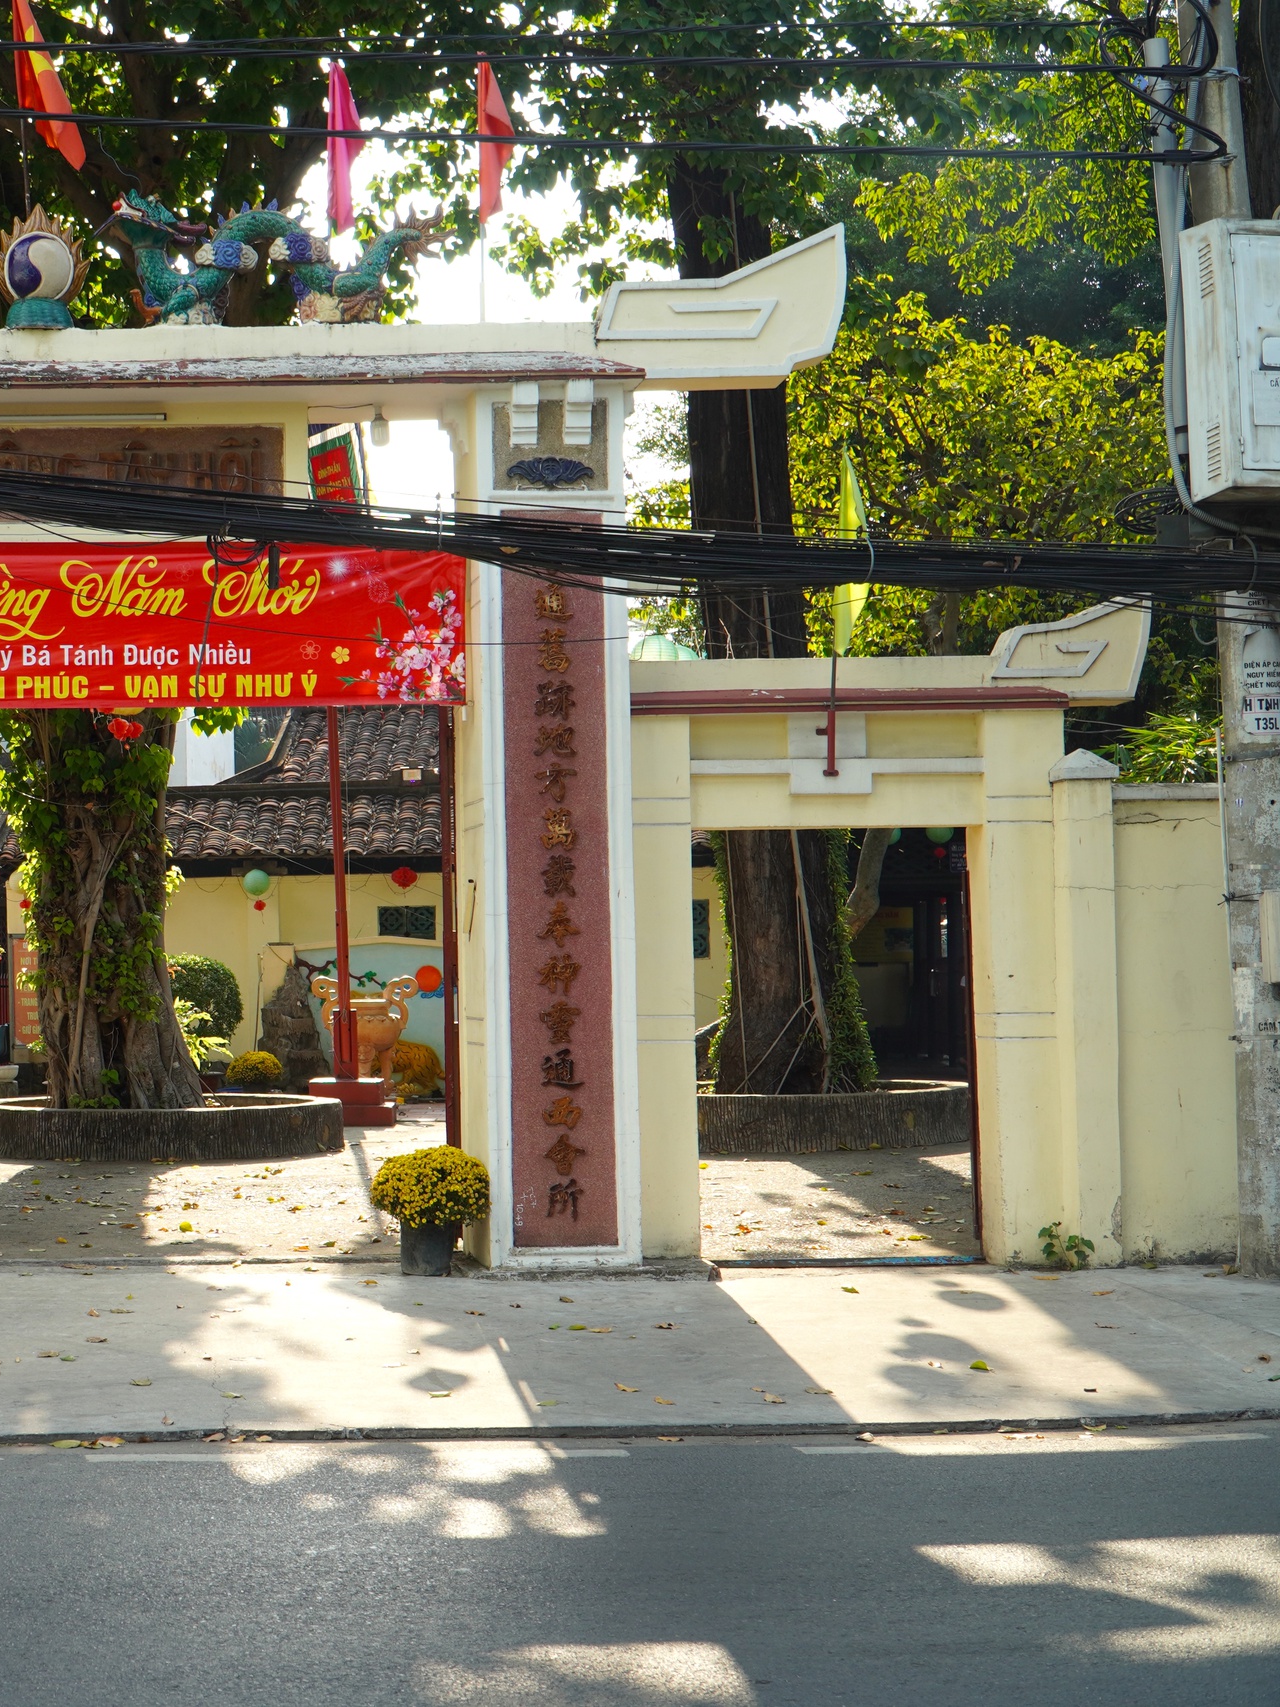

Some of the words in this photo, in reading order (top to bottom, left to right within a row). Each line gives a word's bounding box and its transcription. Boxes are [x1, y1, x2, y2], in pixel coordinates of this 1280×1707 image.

[59, 555, 188, 617] Năm
[202, 557, 320, 617] Mới
[22, 645, 51, 667] Bá
[59, 644, 114, 666] Tánh
[123, 644, 179, 670] Được
[189, 640, 251, 665] Nhiều
[16, 671, 89, 698] PHÚC
[125, 675, 178, 703] VẠN
[189, 672, 227, 703] SỰ
[236, 672, 293, 698] NHƯ
[301, 669, 318, 697] Ý
